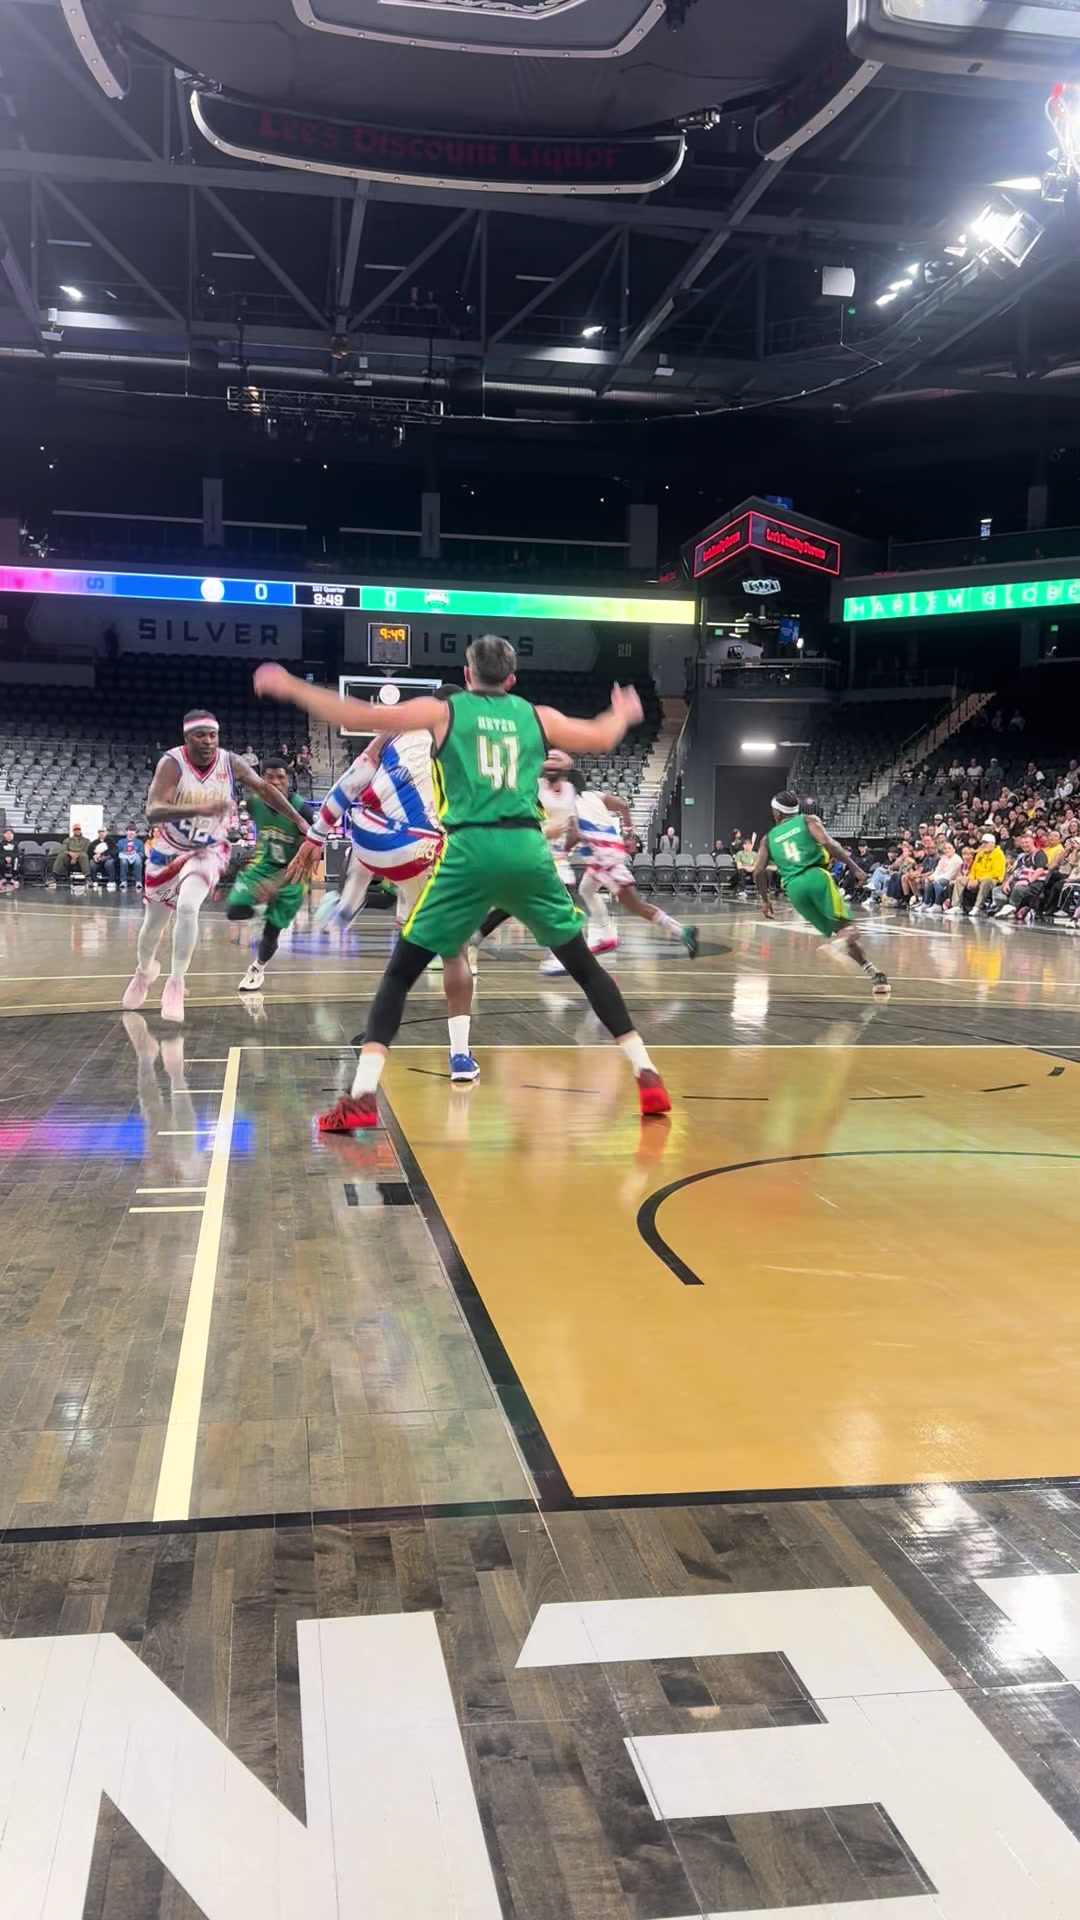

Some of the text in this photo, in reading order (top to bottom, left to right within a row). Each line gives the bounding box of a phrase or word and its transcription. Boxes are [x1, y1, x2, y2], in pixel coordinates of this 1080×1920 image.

[257, 111, 624, 176] Lee's Discount Liquor
[254, 583, 268, 600] 0
[384, 590, 397, 608] 0
[853, 591, 962, 616] HARLEM
[138, 618, 279, 646] SILVER
[379, 627, 406, 642] 9:49
[782, 840, 801, 863] 4
